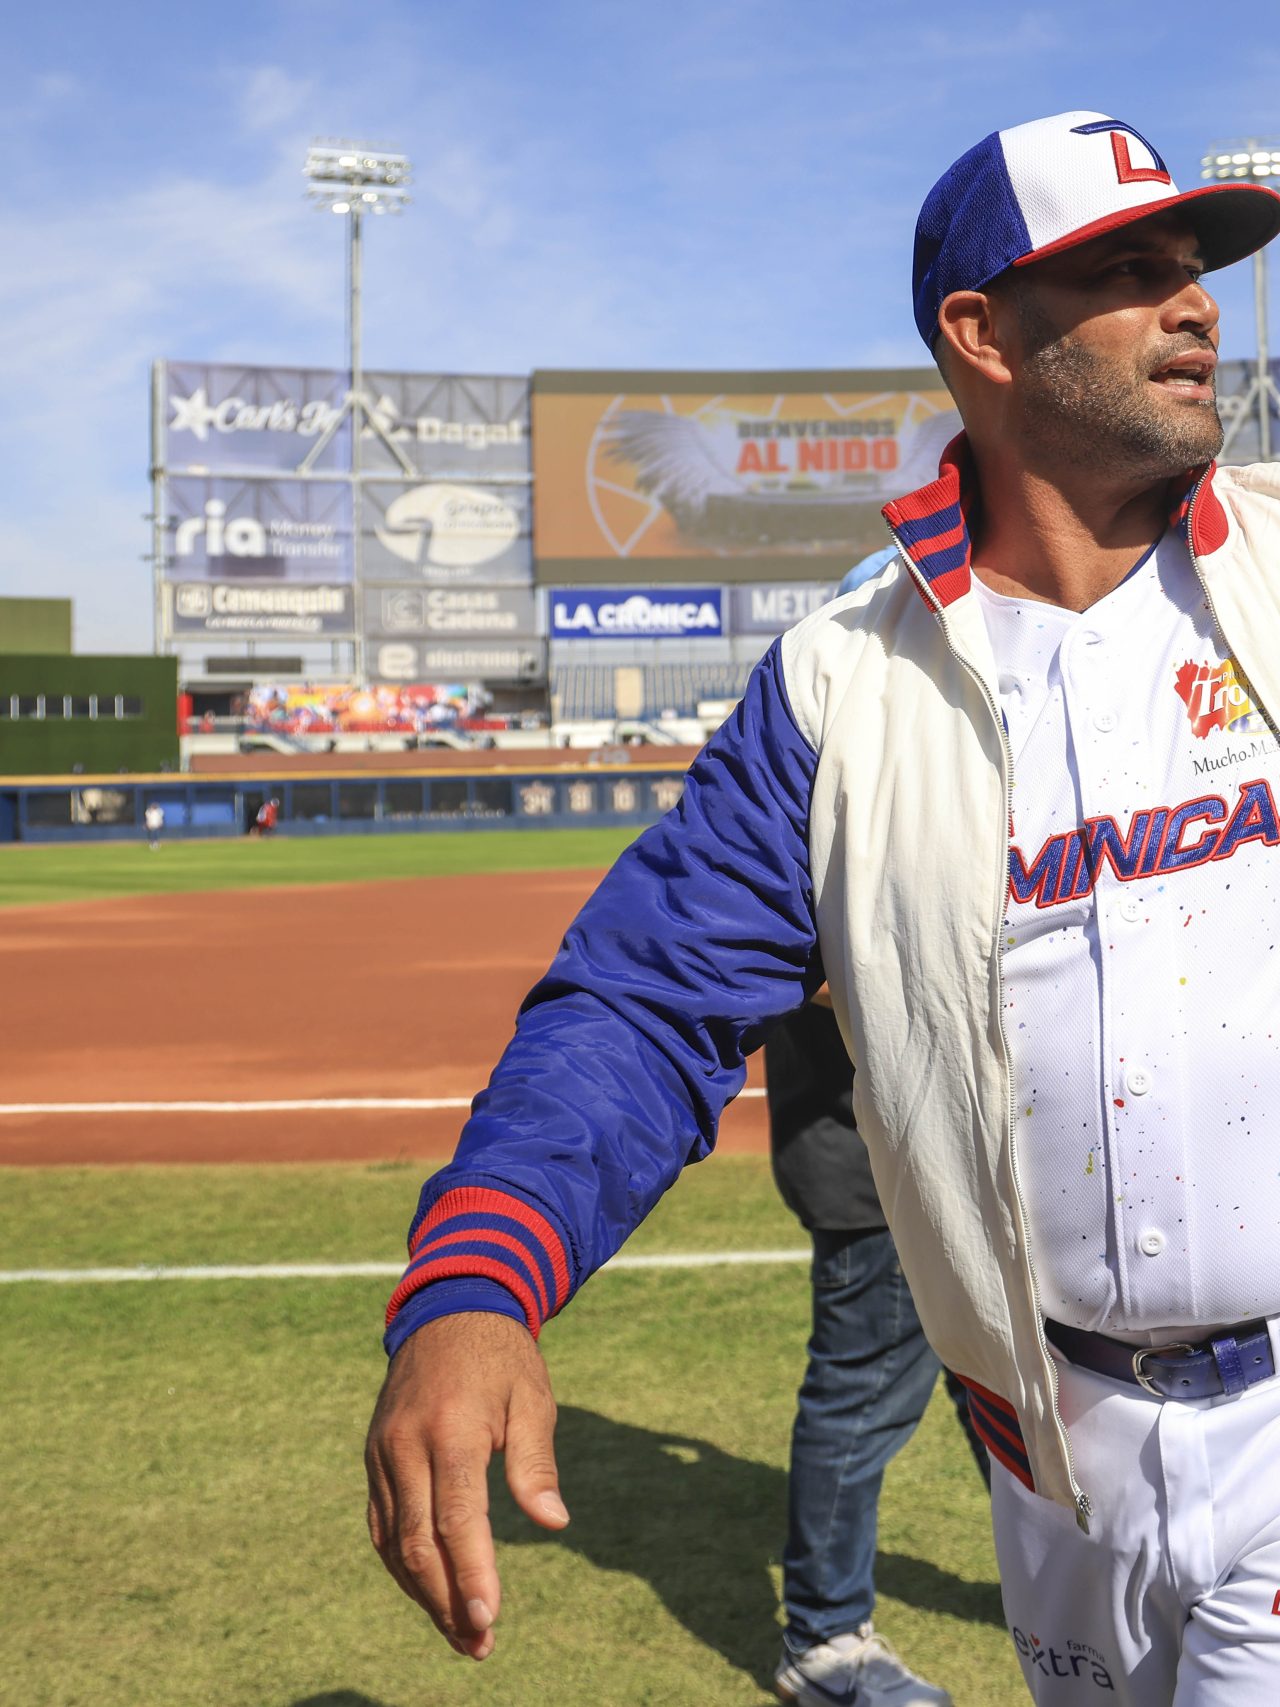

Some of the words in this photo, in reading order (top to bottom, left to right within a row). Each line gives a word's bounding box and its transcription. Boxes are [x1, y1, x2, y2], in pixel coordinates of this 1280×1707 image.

[738, 420, 895, 438] BIENVENIDOS
[737, 440, 788, 473] AL
[797, 438, 898, 472] NIDO
[175, 498, 266, 558] ria
[554, 603, 596, 629] LA
[1013, 1626, 1115, 1691] extra
[1066, 1640, 1106, 1663] farma
